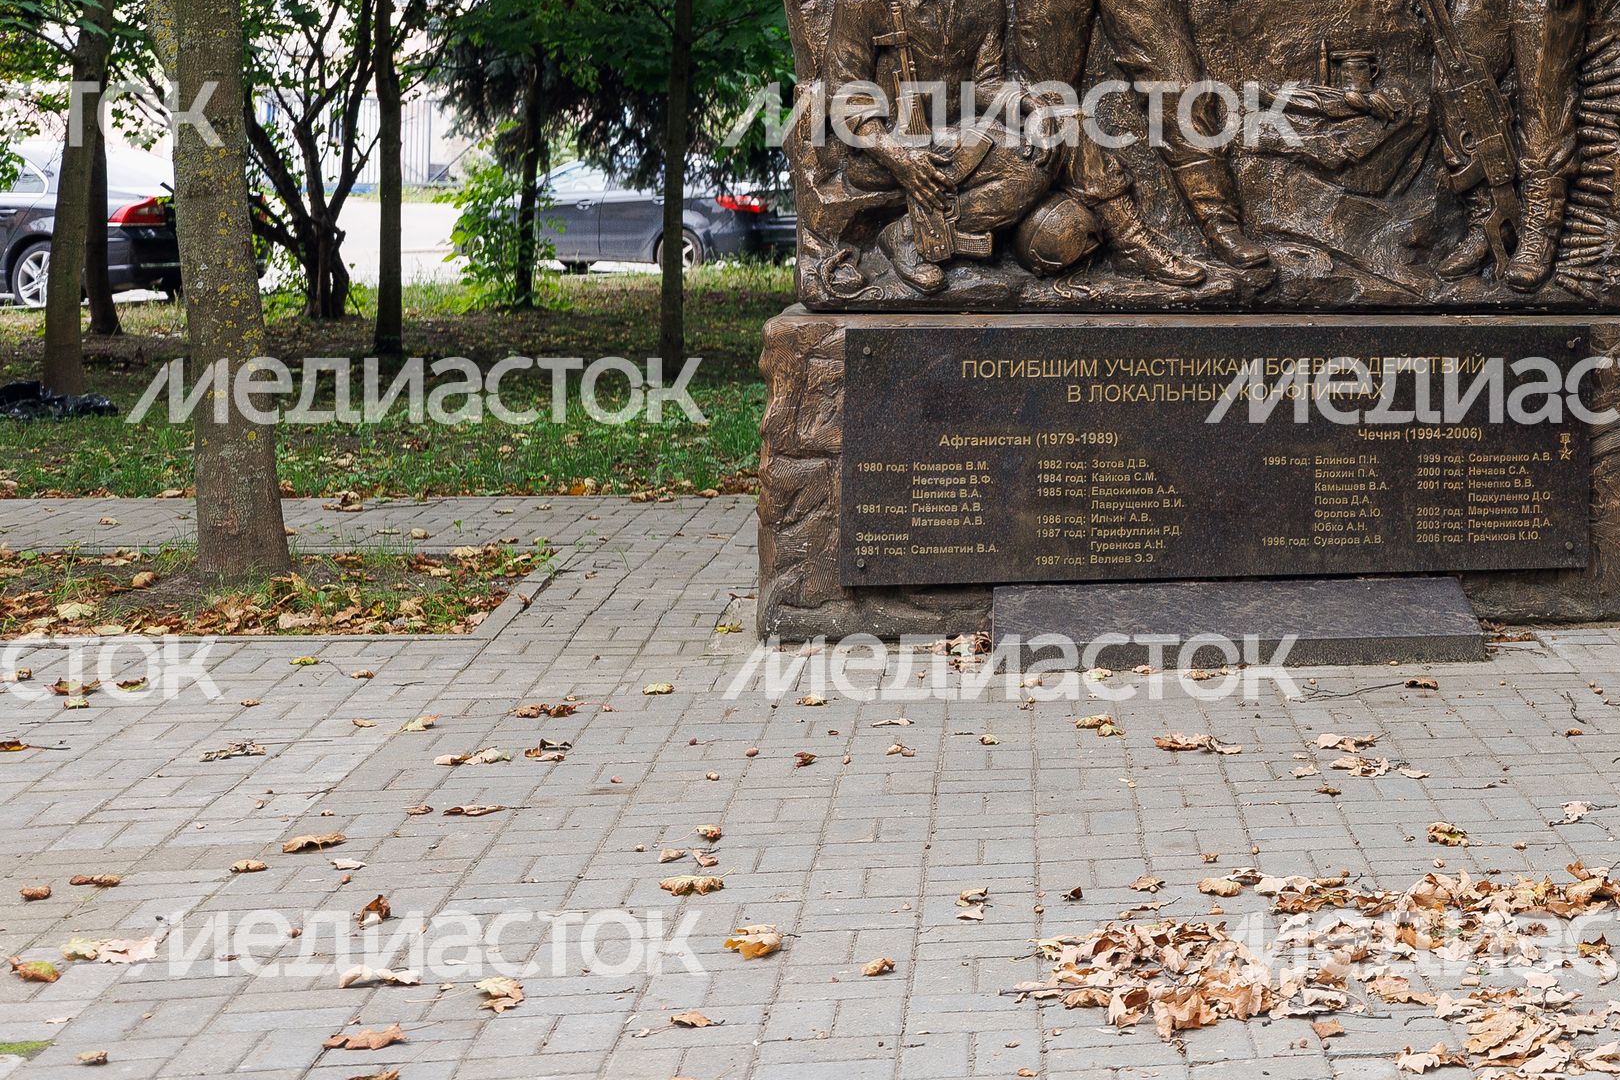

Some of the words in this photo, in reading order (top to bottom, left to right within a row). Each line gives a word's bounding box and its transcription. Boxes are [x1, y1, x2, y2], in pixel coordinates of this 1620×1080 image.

[962, 360, 1098, 378] ПОГИБШИМ
[1105, 358, 1258, 377] УЧАСТНИКАМ
[1266, 357, 1361, 375] БОЕВЫХ
[1366, 353, 1486, 376] ДЕЙСТВИЙ
[1067, 385, 1081, 403] В
[1088, 383, 1232, 403] ЛОКАЛЬНЫХ
[1239, 382, 1387, 403] КОНФЛИКТАХ
[1358, 429, 1401, 441] Чечня
[1405, 427, 1483, 441] (1994-2006)
[939, 434, 1031, 449] Афганистан
[1036, 432, 1118, 448] (1979-1989)
[1263, 457, 1286, 466] 1995
[1290, 457, 1310, 467] год:
[1315, 456, 1355, 465] Блинов
[1359, 455, 1379, 464] П.Н.
[1418, 454, 1440, 463] 1999
[1444, 455, 1464, 464] год:
[1532, 452, 1552, 462] А.В.
[858, 462, 882, 472] 1980
[886, 464, 908, 472] год:
[913, 462, 962, 473] Комаров
[966, 461, 989, 470] В.М.
[1038, 460, 1062, 469] 1982
[1066, 461, 1087, 470] год:
[1092, 459, 1124, 468] Зотов
[1127, 459, 1149, 469] Д.В.
[1315, 469, 1354, 478] Блохин
[1358, 469, 1378, 477] П.А.
[1417, 468, 1440, 476] 2000
[1444, 468, 1464, 477] год:
[1468, 467, 1505, 476] Нечаев
[1508, 466, 1528, 475] С.А.
[912, 476, 966, 486] Нестеров
[970, 475, 993, 484] В.Ф.
[1038, 474, 1062, 483] 1984
[1065, 475, 1087, 484] год:
[1092, 472, 1130, 482] Кайков
[1134, 472, 1157, 481] С.М.
[1315, 482, 1365, 492] Камышев
[1369, 482, 1390, 490] В.А.
[1417, 481, 1440, 490] 2001
[1443, 482, 1464, 490] год:
[1514, 479, 1534, 488] В.В.
[960, 489, 982, 498] В.А.
[1038, 488, 1061, 496] 1985
[1065, 488, 1086, 498] год:
[1092, 487, 1153, 496] Евдокимов
[1157, 486, 1178, 494] А.А.
[1091, 500, 1159, 511] Лаврущенко
[1163, 499, 1184, 508] В.И.
[1315, 496, 1348, 505] Попов
[1351, 495, 1372, 506] Д.А.
[856, 504, 881, 513] 1981
[885, 505, 908, 514] год:
[912, 503, 958, 512] Гнёнков
[961, 503, 984, 512] А.В.
[1314, 509, 1356, 520] Фролов
[1417, 507, 1440, 516] 2002
[1443, 508, 1464, 517] год:
[1468, 506, 1518, 517] Марченко
[1522, 505, 1542, 514] М.П.
[912, 517, 960, 526] Матвеев
[963, 516, 986, 525] А.В.
[1037, 515, 1061, 524] 1986
[1064, 516, 1086, 525] год:
[1130, 513, 1152, 522] А.В.
[1417, 521, 1440, 530] 2003
[1443, 522, 1463, 530] год:
[1468, 519, 1529, 530] Печерников
[1532, 518, 1552, 528] Д.А.
[1037, 529, 1061, 538] 1987
[1064, 530, 1086, 539] год:
[1090, 527, 1159, 538] Гарифуллин
[1163, 526, 1182, 536] Р.Д.
[1346, 522, 1367, 531] А.Н.
[856, 532, 908, 543] Эфиопия
[1262, 537, 1285, 546] 1996
[1289, 538, 1310, 547] год:
[1314, 536, 1360, 547] Суворов
[1363, 535, 1384, 544] А.В.
[1416, 534, 1440, 542] 2006
[1442, 534, 1463, 544] год:
[1468, 532, 1515, 544] Грачиков
[1518, 531, 1540, 541] К.Ю.
[855, 546, 879, 555] 1981
[884, 547, 906, 556] год:
[911, 545, 973, 554] Саламатин
[977, 544, 999, 552] В.А.
[1090, 541, 1141, 552] Гуренков
[1144, 540, 1166, 549] А.Н.
[1036, 556, 1060, 565] 1987
[1063, 557, 1085, 566] год:
[1090, 554, 1131, 564] Велиев
